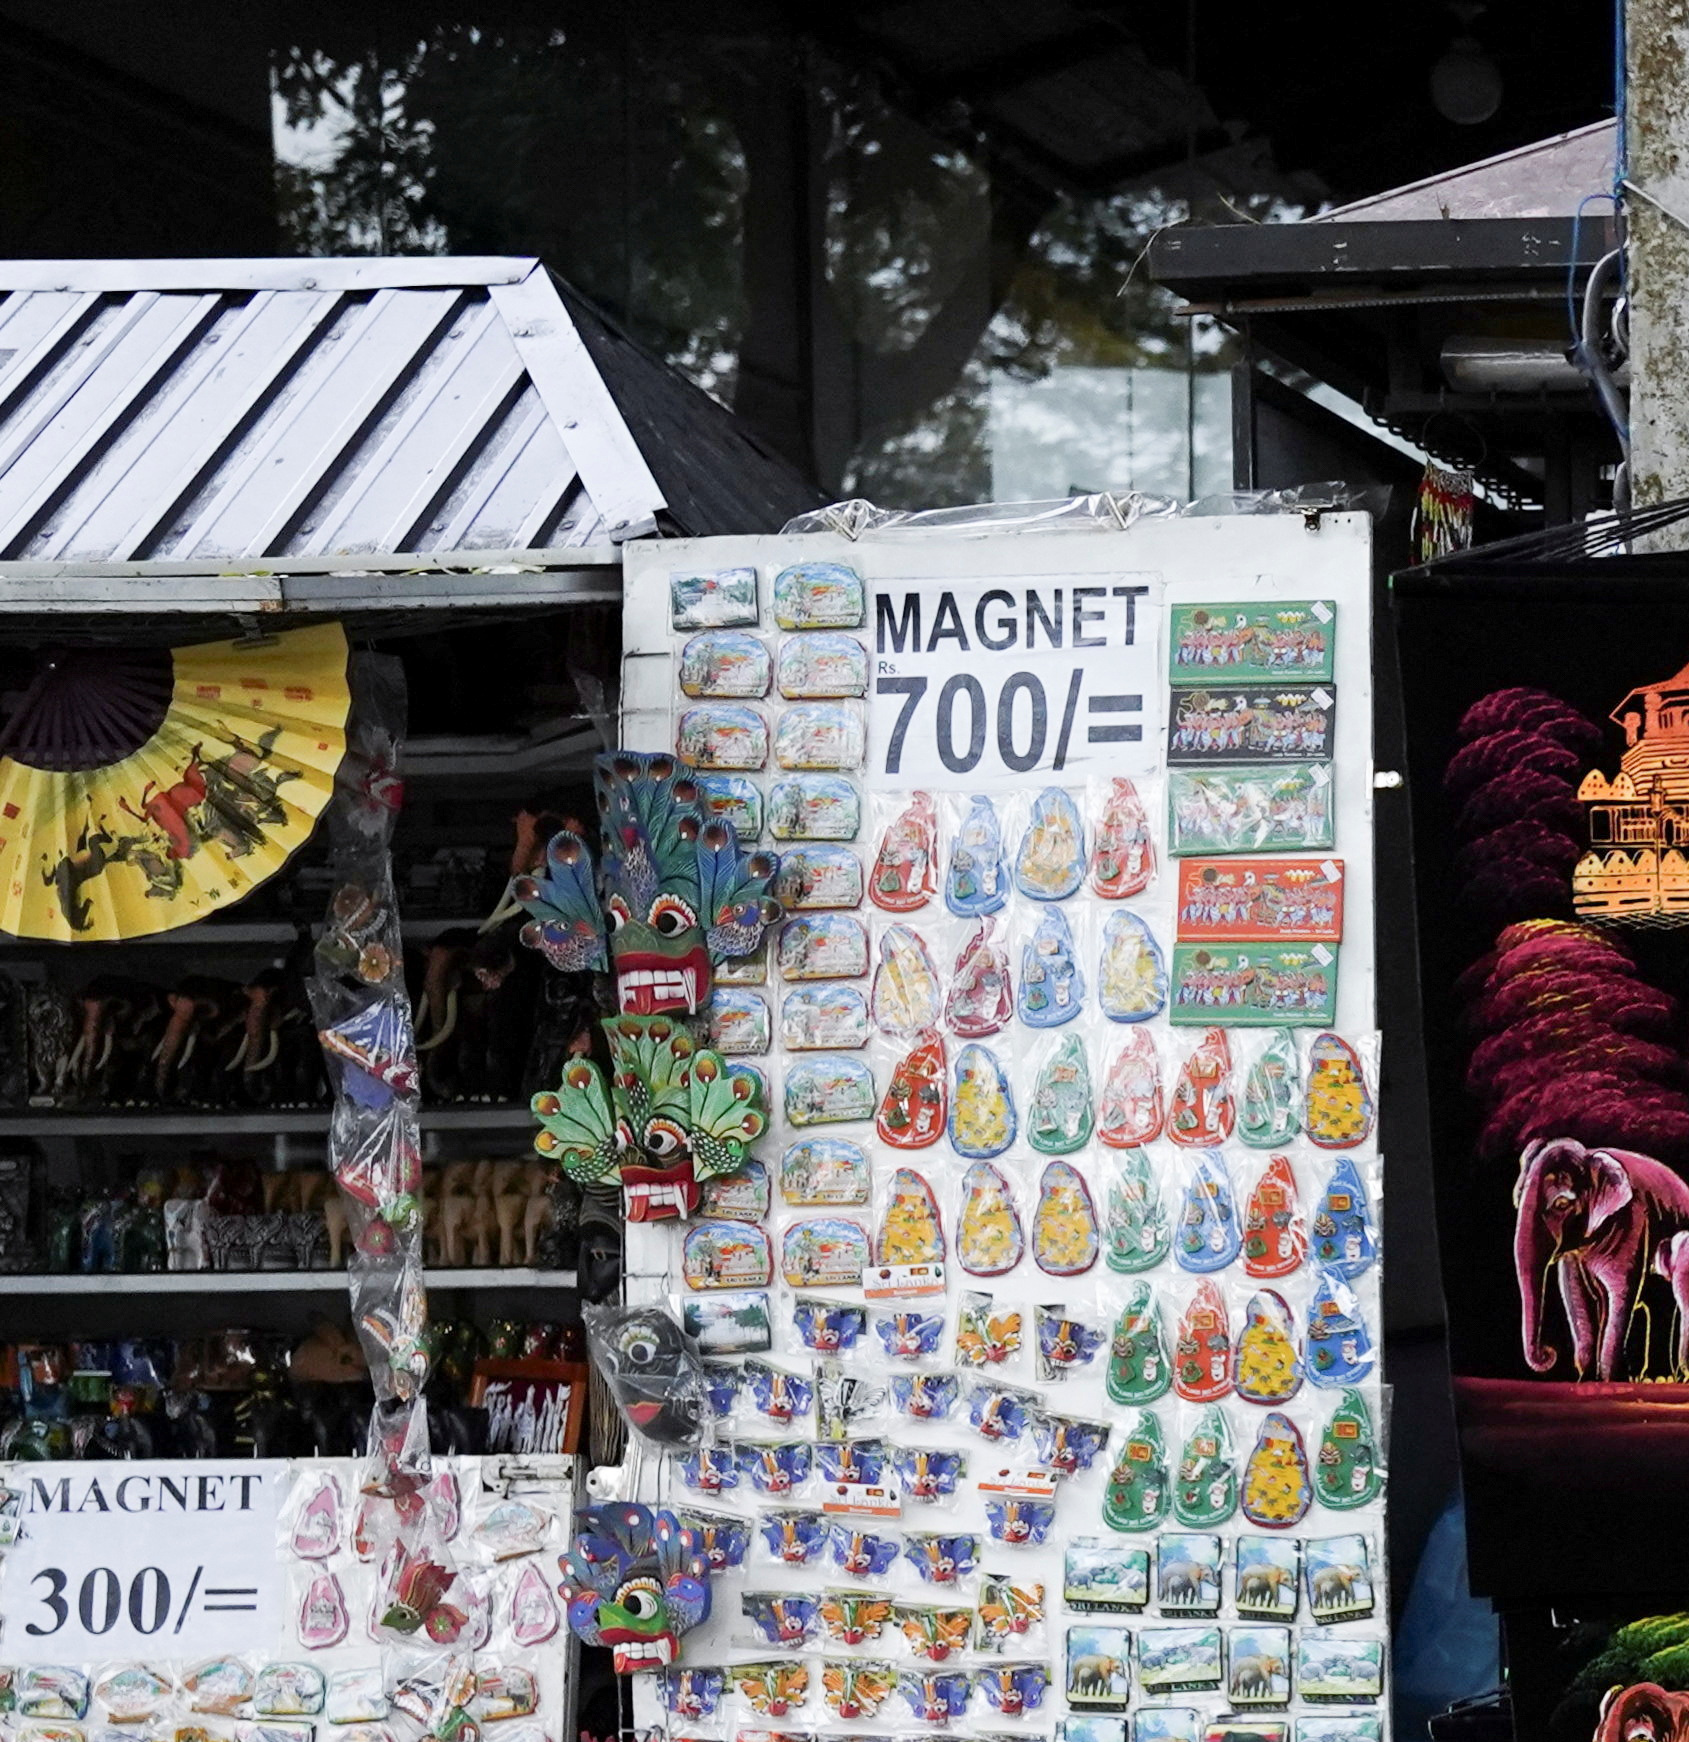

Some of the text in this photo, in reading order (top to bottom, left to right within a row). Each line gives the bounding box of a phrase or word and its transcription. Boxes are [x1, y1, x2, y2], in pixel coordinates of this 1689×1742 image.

[875, 585, 1149, 654] MAGNET
[878, 661, 900, 674] Rs.
[876, 669, 1143, 774] 700/=
[29, 1475, 262, 1513] MAGNET
[25, 1566, 258, 1635] 300/=
